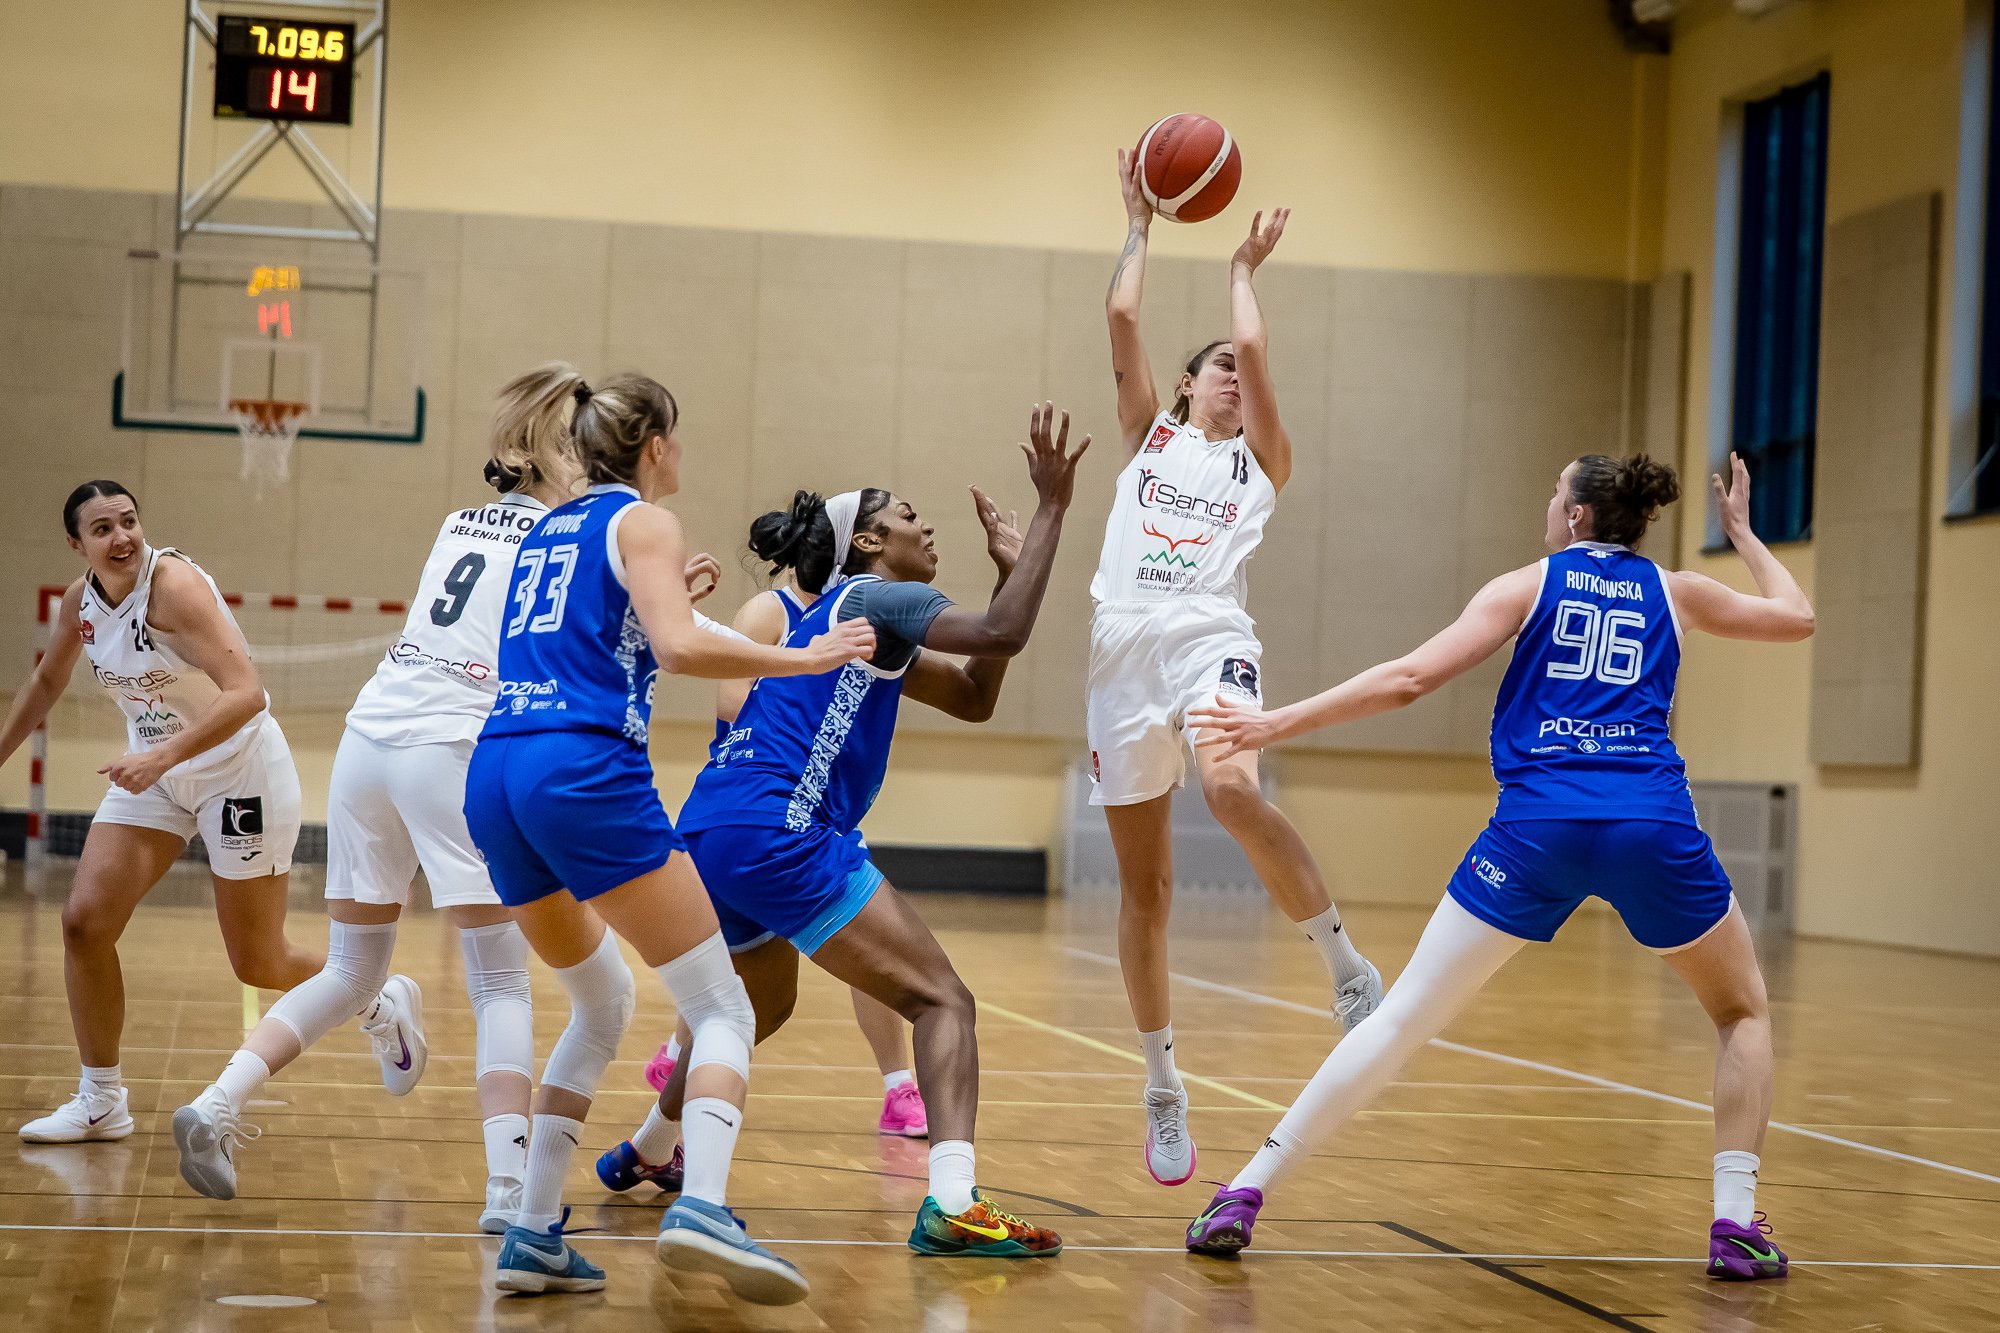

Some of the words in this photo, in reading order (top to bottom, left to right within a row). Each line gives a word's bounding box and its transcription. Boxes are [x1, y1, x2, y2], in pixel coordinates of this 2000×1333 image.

[270, 68, 317, 112] 14
[450, 525, 501, 542] JELENIA
[429, 551, 487, 628] 9
[506, 543, 580, 639] 33
[1566, 570, 1644, 602] RUTKOWSKA
[130, 618, 156, 653] 24
[1546, 599, 1646, 686] 96
